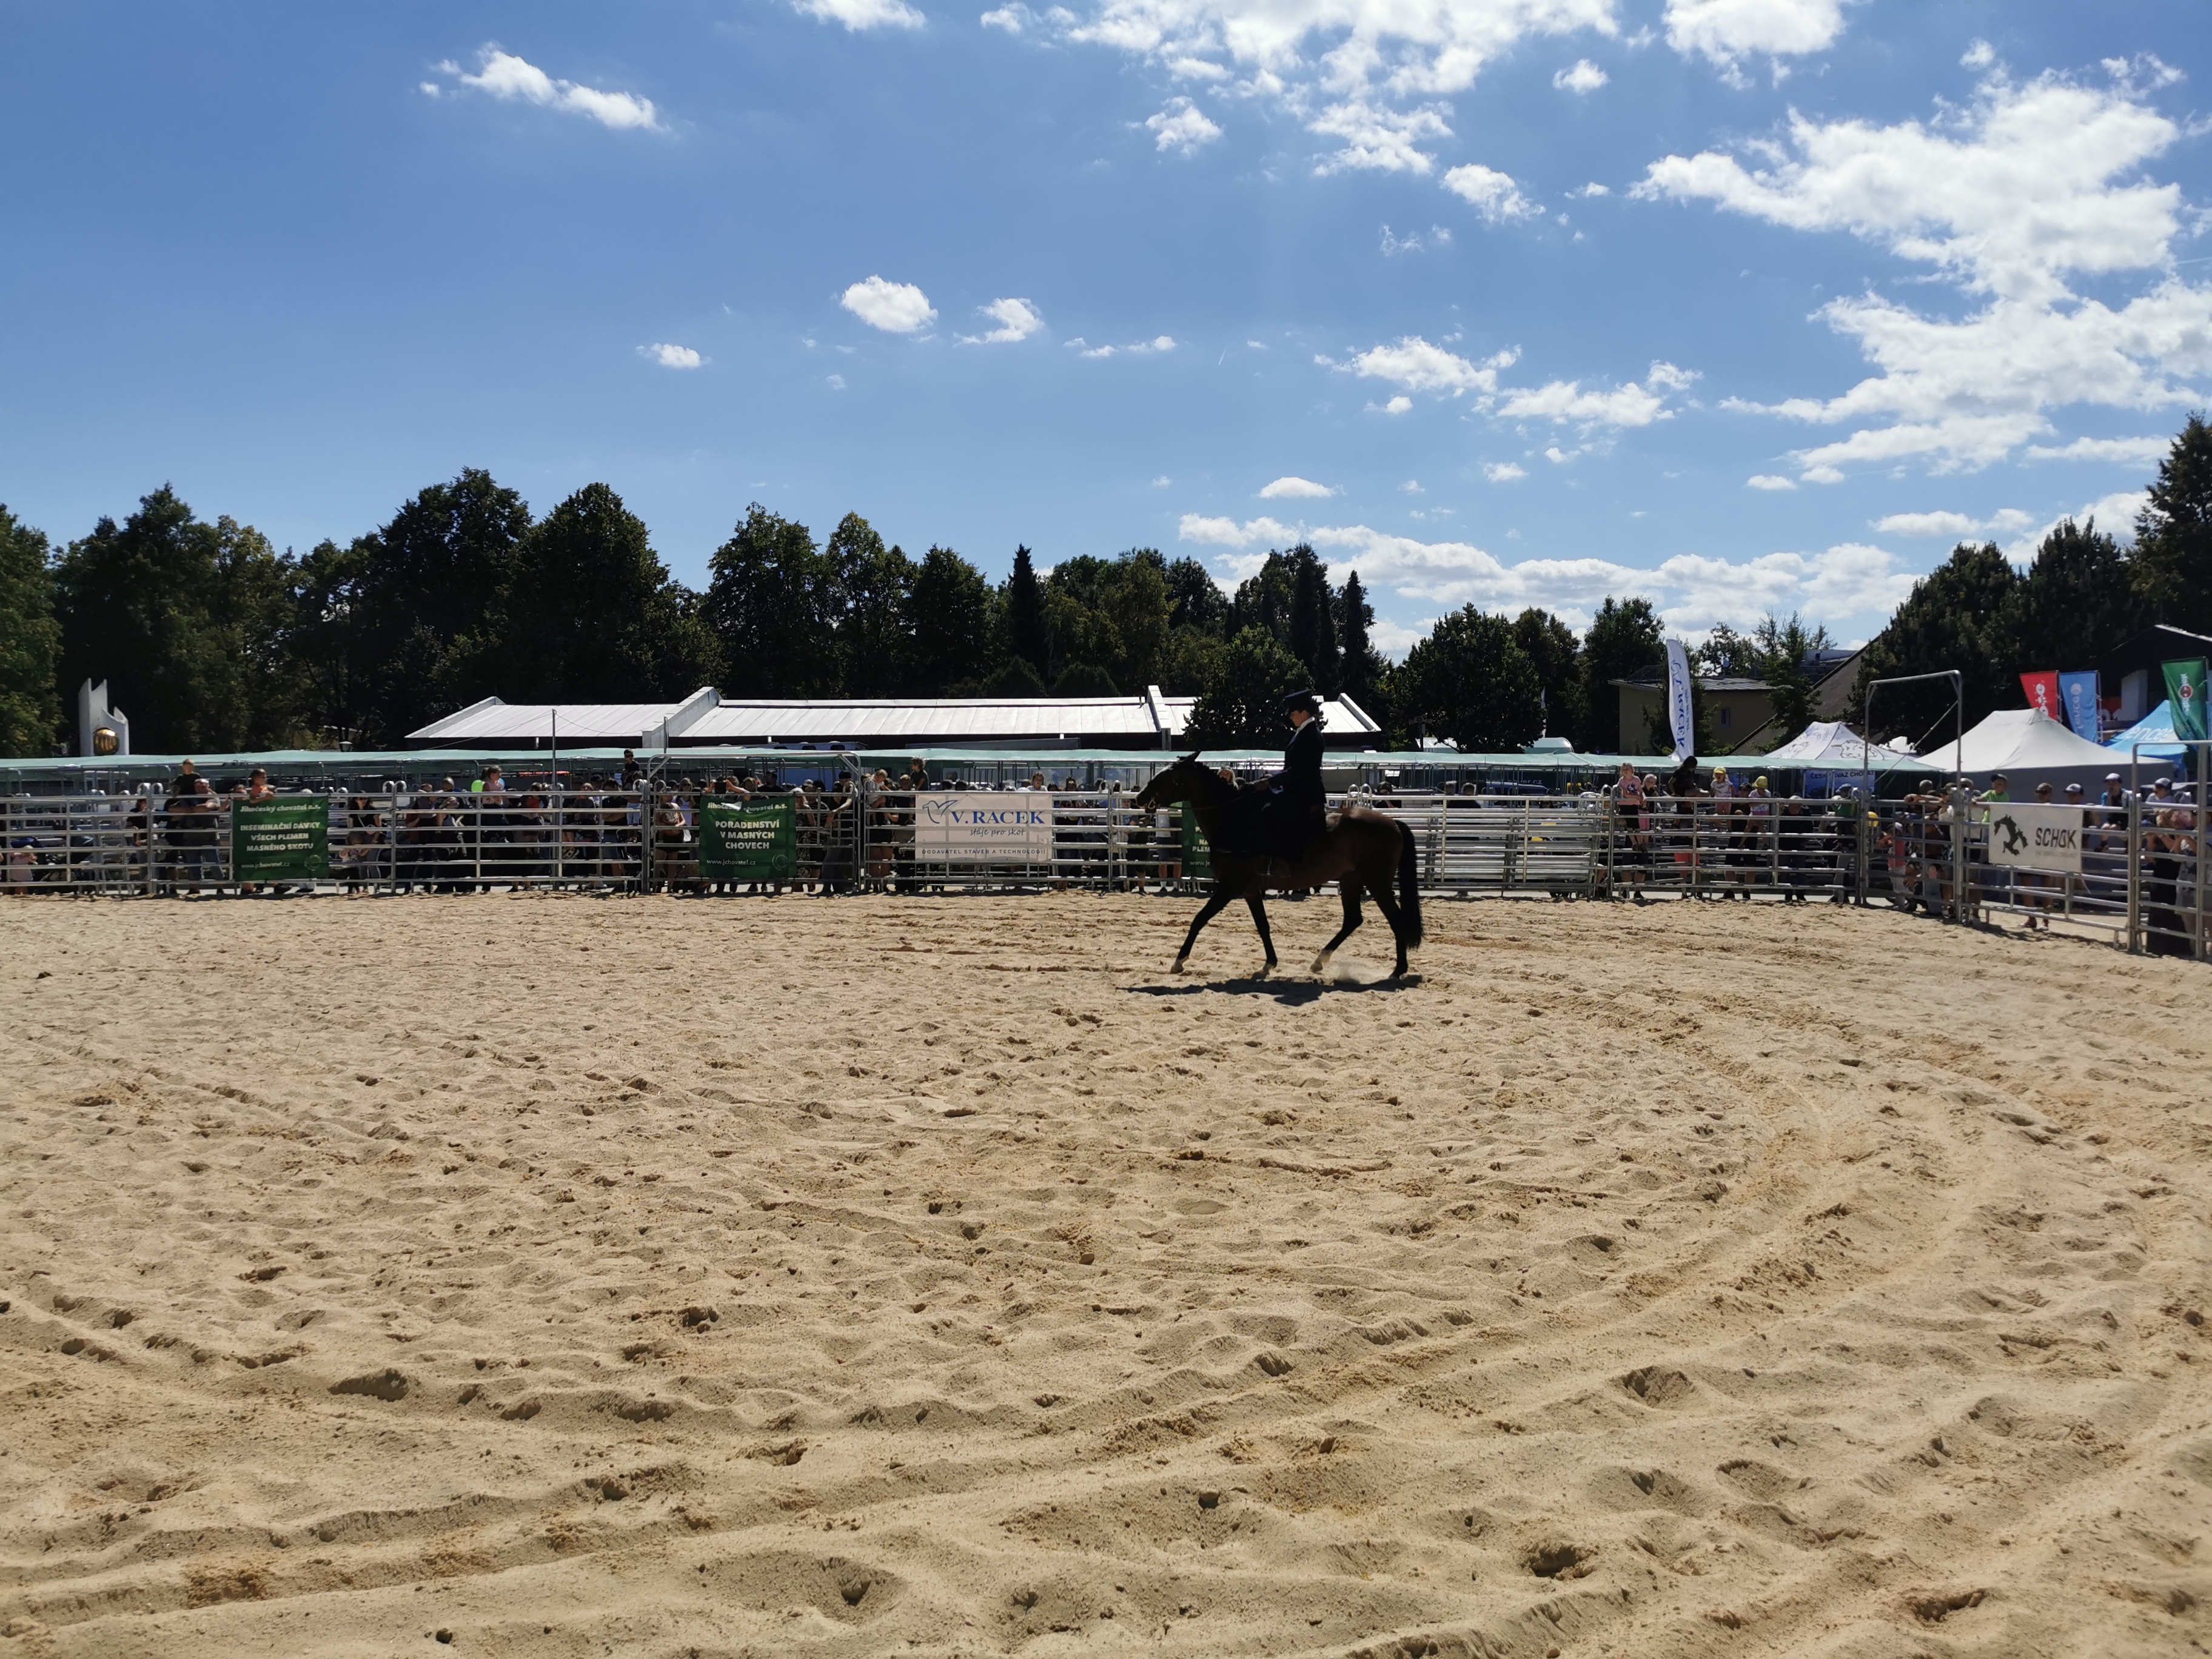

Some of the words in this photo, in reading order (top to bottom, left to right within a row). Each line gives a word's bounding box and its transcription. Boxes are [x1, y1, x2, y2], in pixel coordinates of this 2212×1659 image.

[972, 811, 1045, 824] RACEK
[240, 822, 292, 831] INSEMINAČNÍ
[715, 819, 780, 829] PORADENSTVÍ
[728, 830, 775, 839] MASNÝCH
[970, 828, 990, 837] stáje
[1008, 827, 1026, 836] skot
[2035, 827, 2077, 850] SCHOK
